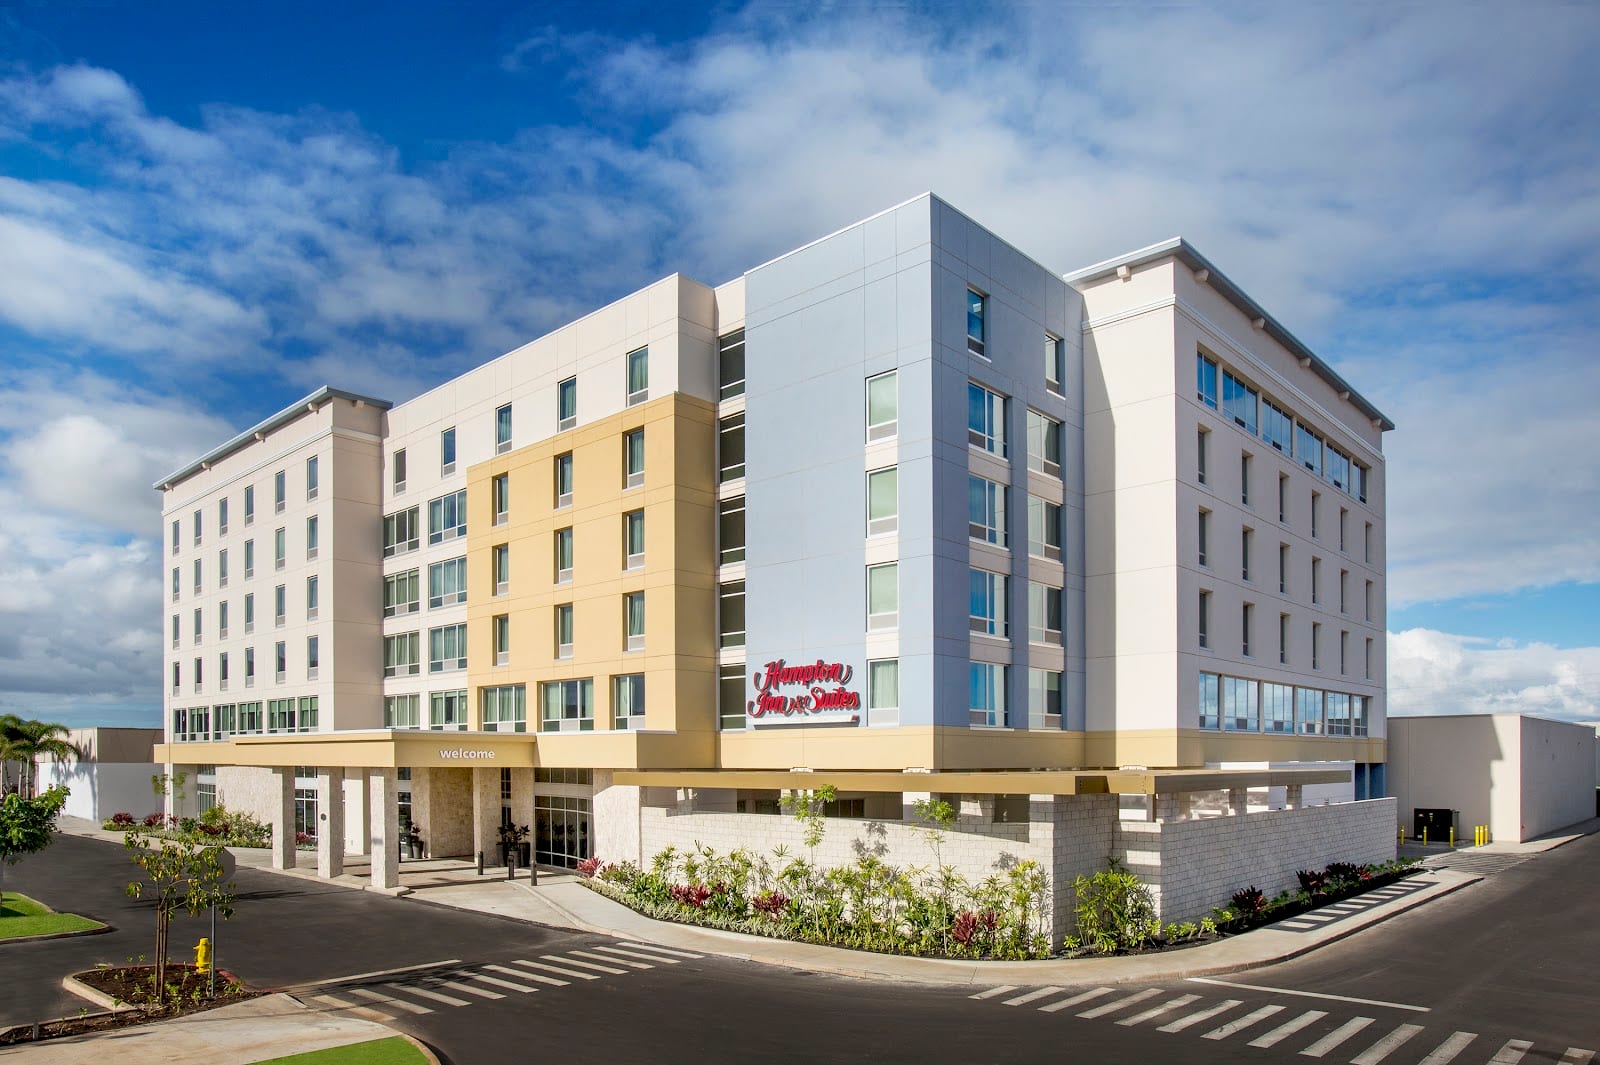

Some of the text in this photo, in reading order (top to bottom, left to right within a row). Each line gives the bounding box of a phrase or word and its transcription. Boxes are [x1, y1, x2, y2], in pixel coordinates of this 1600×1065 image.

[753, 659, 852, 691] Hampton
[748, 687, 860, 717] Inn & Suites
[439, 748, 495, 759] welcome
